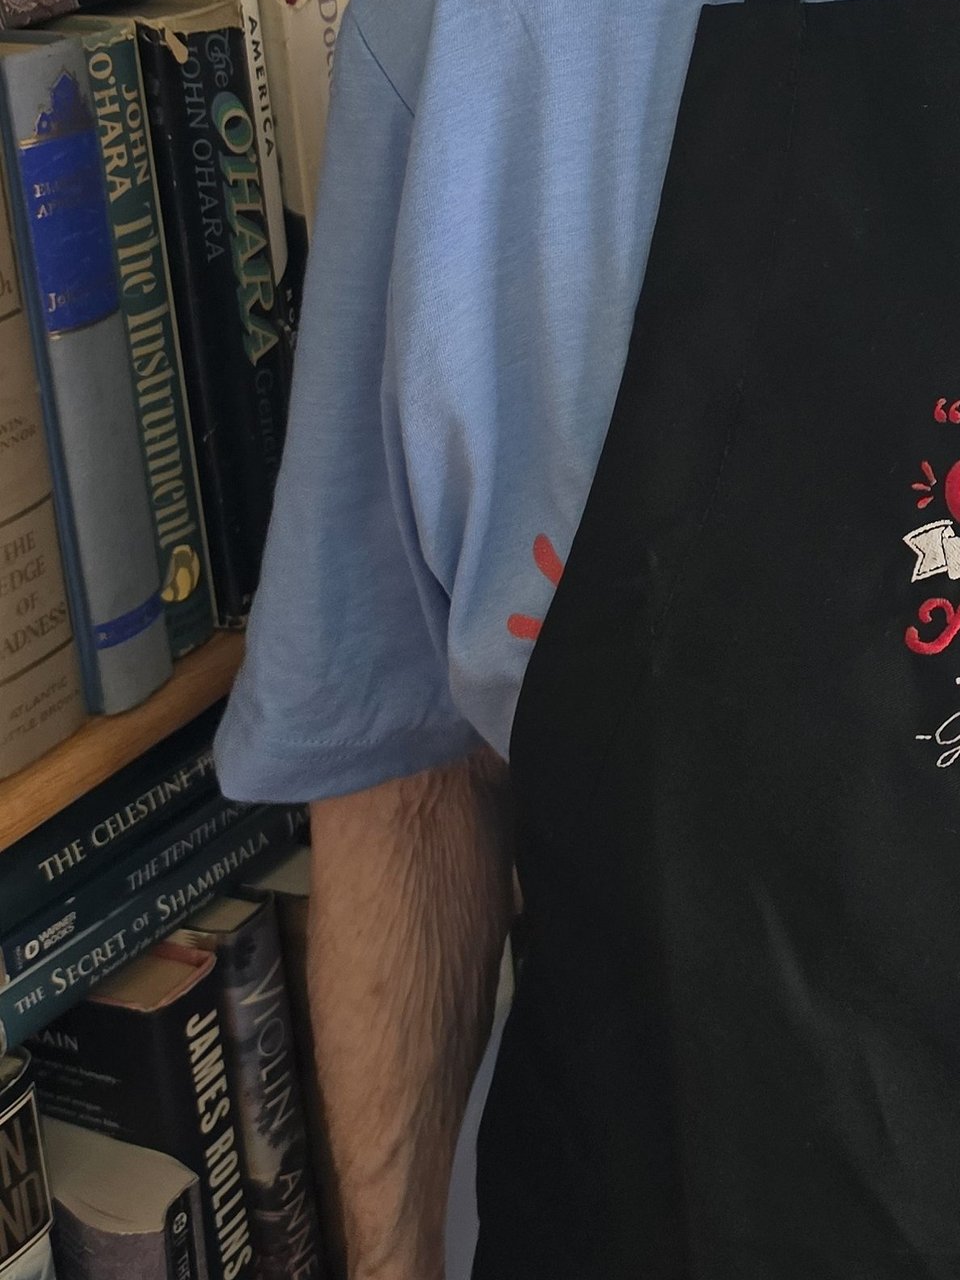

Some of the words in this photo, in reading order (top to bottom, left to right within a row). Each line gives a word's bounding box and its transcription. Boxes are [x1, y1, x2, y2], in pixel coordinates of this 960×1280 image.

[181, 46, 209, 130] JOHN
[204, 31, 234, 89] The
[248, 15, 275, 159] AMERICA
[88, 50, 134, 203] O'HARA
[121, 83, 151, 187] JOHN
[109, 200, 157, 299] The
[191, 138, 226, 264] O'HARA
[211, 90, 280, 367] O'HARA
[124, 302, 197, 549] Instrument
[4, 529, 36, 562] THE
[15, 591, 40, 618] OF
[38, 838, 87, 883] THE
[91, 766, 201, 849] CELESTINE
[125, 858, 158, 892] THE
[160, 817, 217, 869] TENTH
[38, 911, 77, 942] WARNER
[44, 925, 75, 950] BOOKS
[14, 985, 46, 1015] THE
[239, 956, 297, 1131] VIOLIN
[184, 1008, 232, 1135] JAMES
[201, 1126, 253, 1280] ROLLINS
